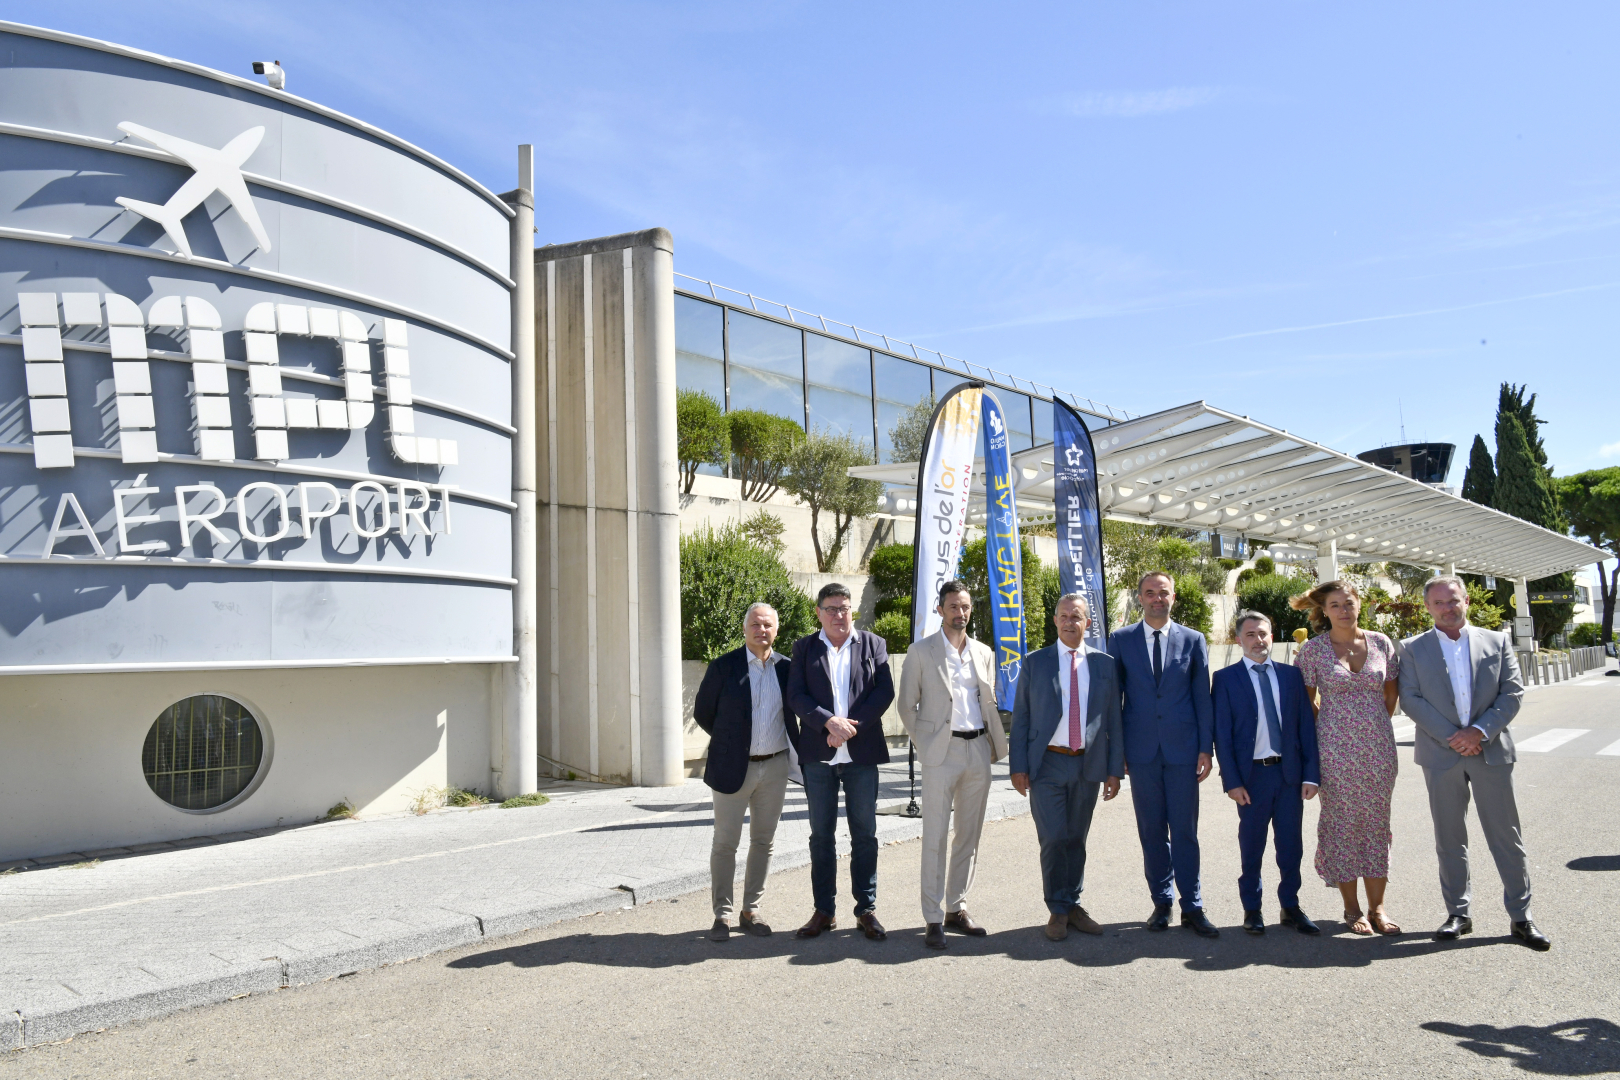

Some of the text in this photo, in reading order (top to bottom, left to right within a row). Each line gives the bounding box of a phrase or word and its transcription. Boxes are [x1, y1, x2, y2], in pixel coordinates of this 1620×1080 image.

[934, 459, 955, 496] l'or
[41, 473, 459, 559] AÉROPORT
[933, 500, 953, 535] de
[1224, 542, 1233, 550] HALL
[1244, 543, 1248, 554] B
